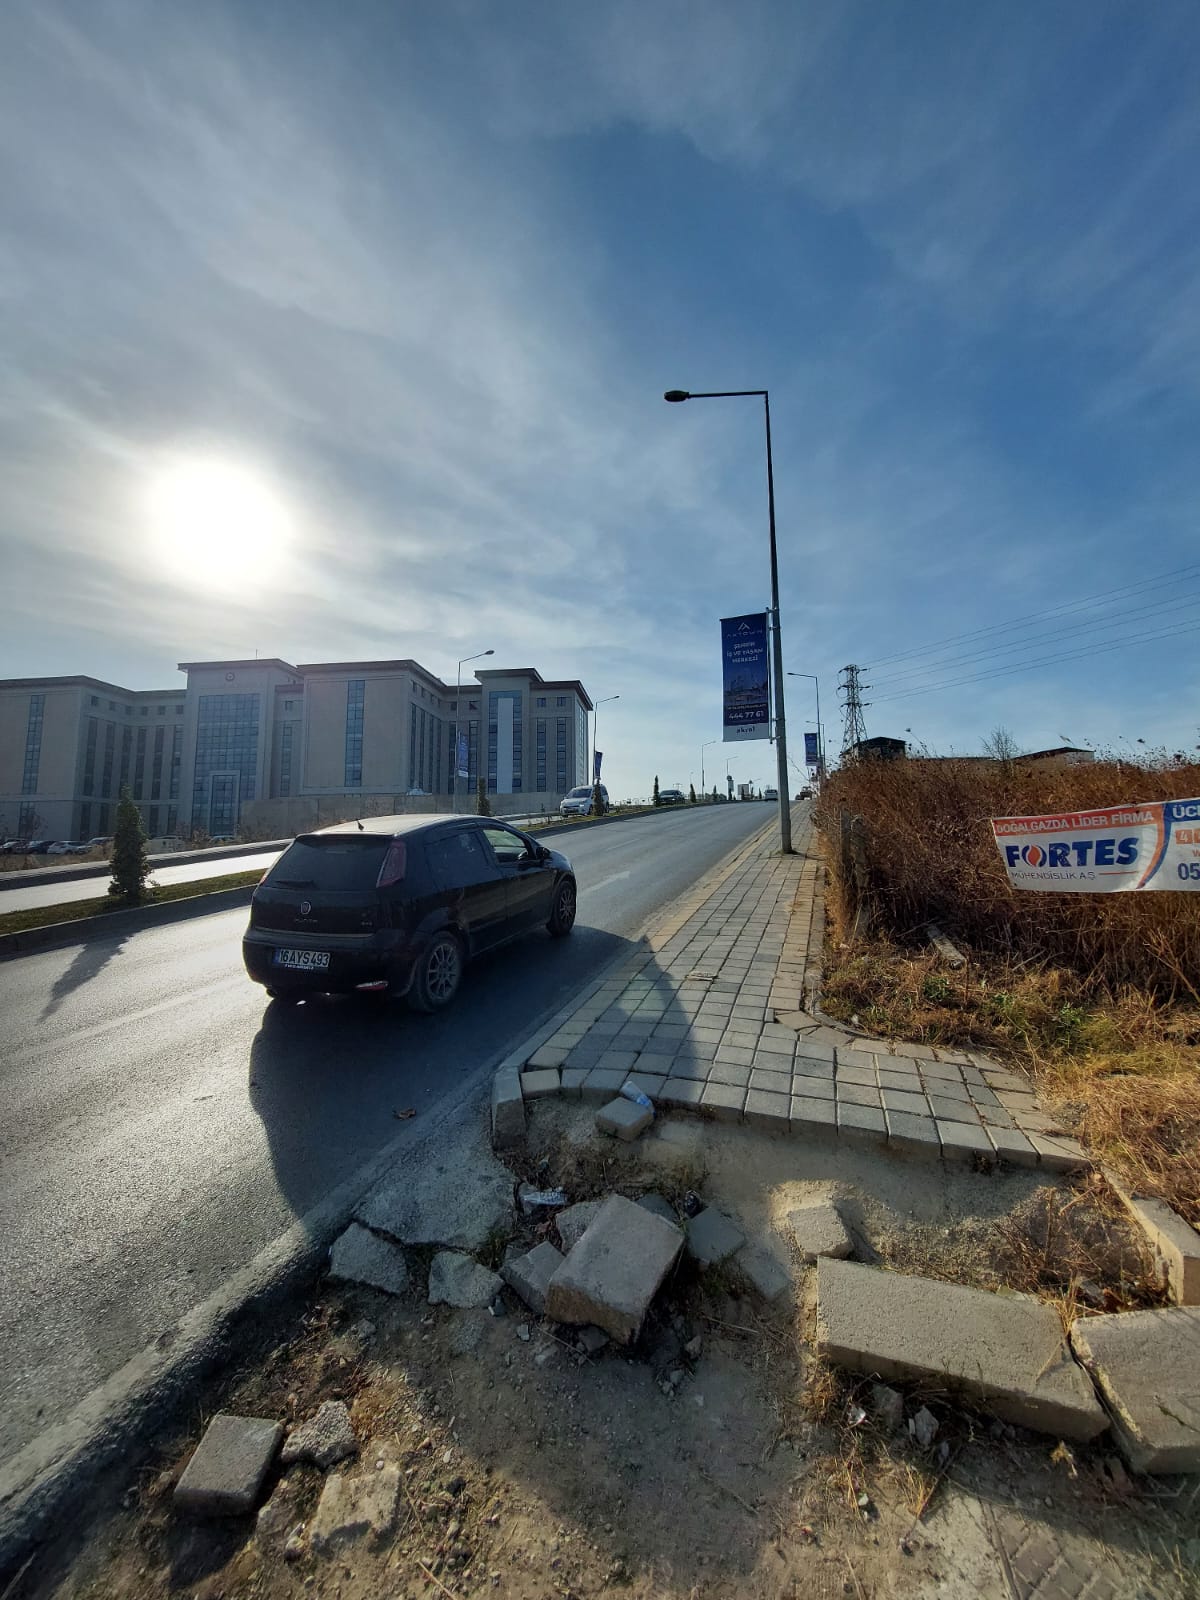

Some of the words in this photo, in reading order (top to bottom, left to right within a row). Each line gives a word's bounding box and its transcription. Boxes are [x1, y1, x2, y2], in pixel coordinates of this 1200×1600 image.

[996, 818, 1070, 834] DOĞALGAZDA
[1071, 815, 1108, 828] LİDER
[1111, 810, 1154, 825] FİRMA
[1172, 804, 1200, 819] ÜC
[1005, 837, 1140, 868] FORTES
